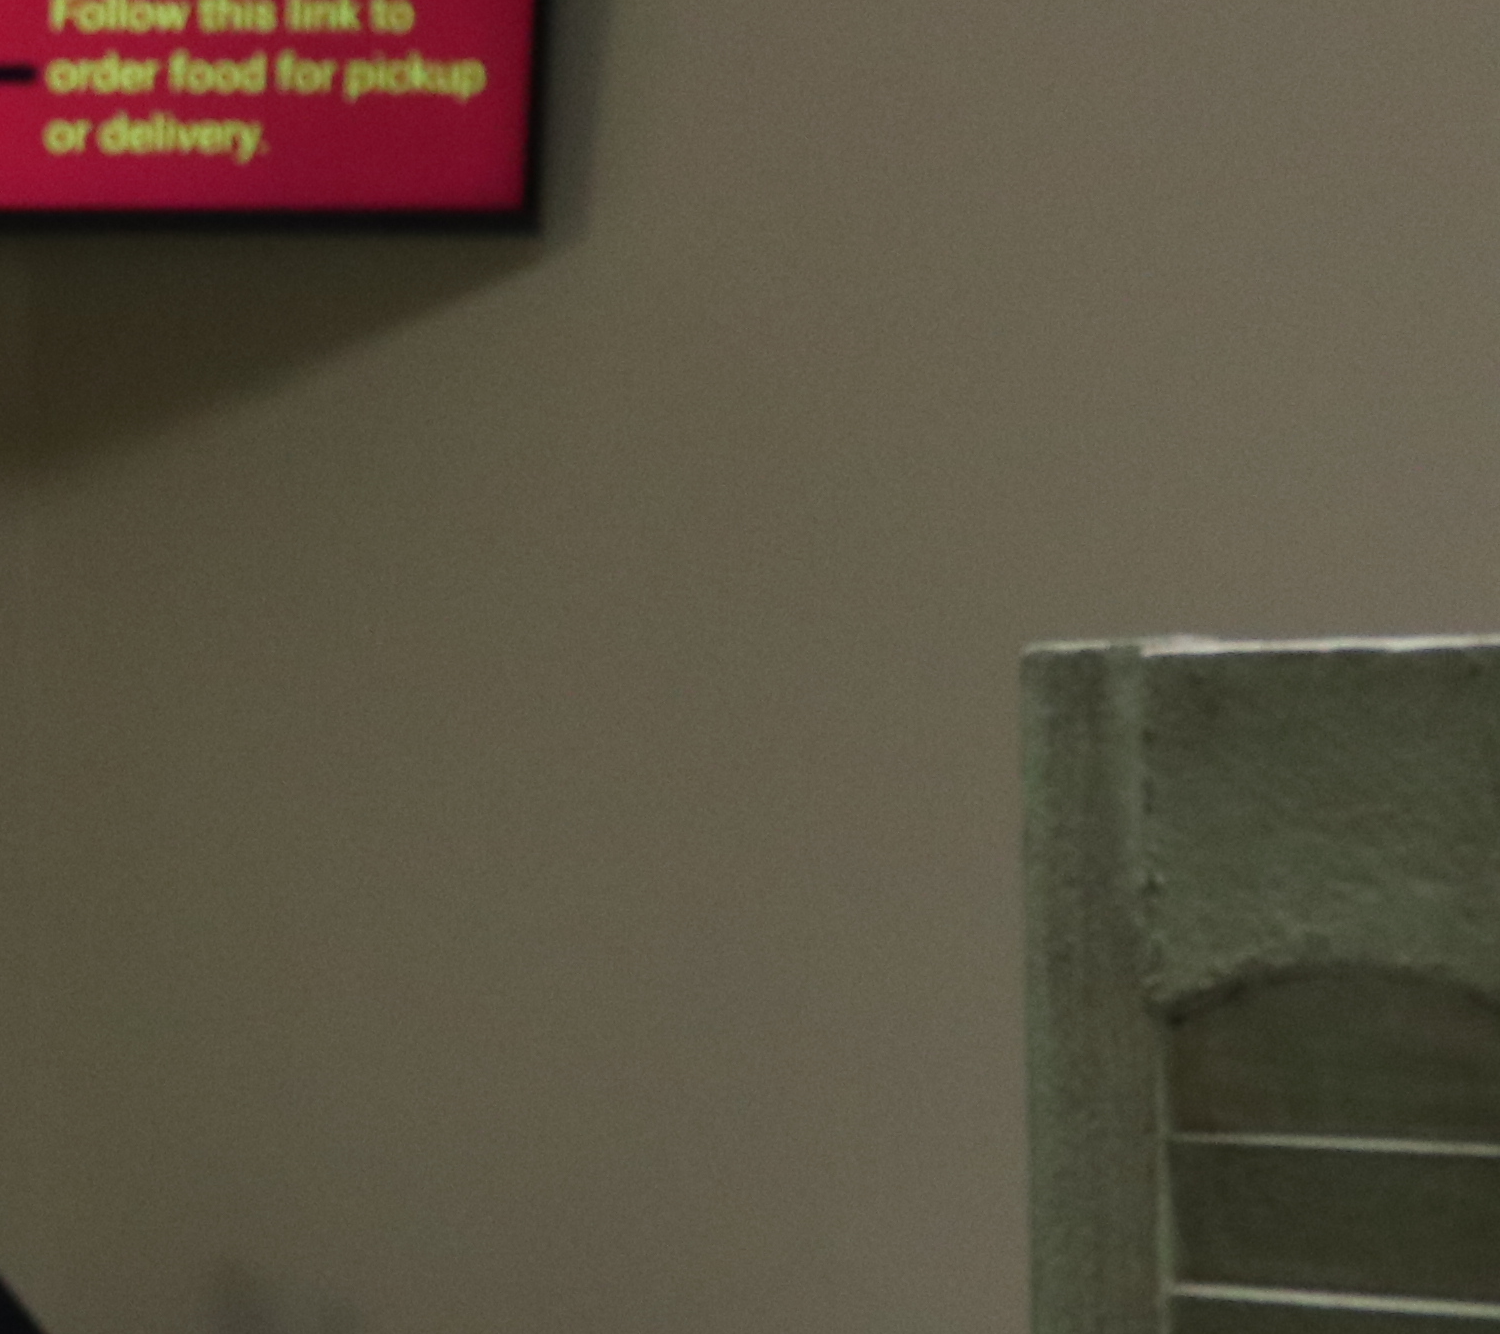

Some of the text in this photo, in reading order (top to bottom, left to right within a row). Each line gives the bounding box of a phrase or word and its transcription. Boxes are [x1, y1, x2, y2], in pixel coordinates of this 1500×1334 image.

[44, 48, 487, 103] order food for pickup
[42, 117, 93, 155] or
